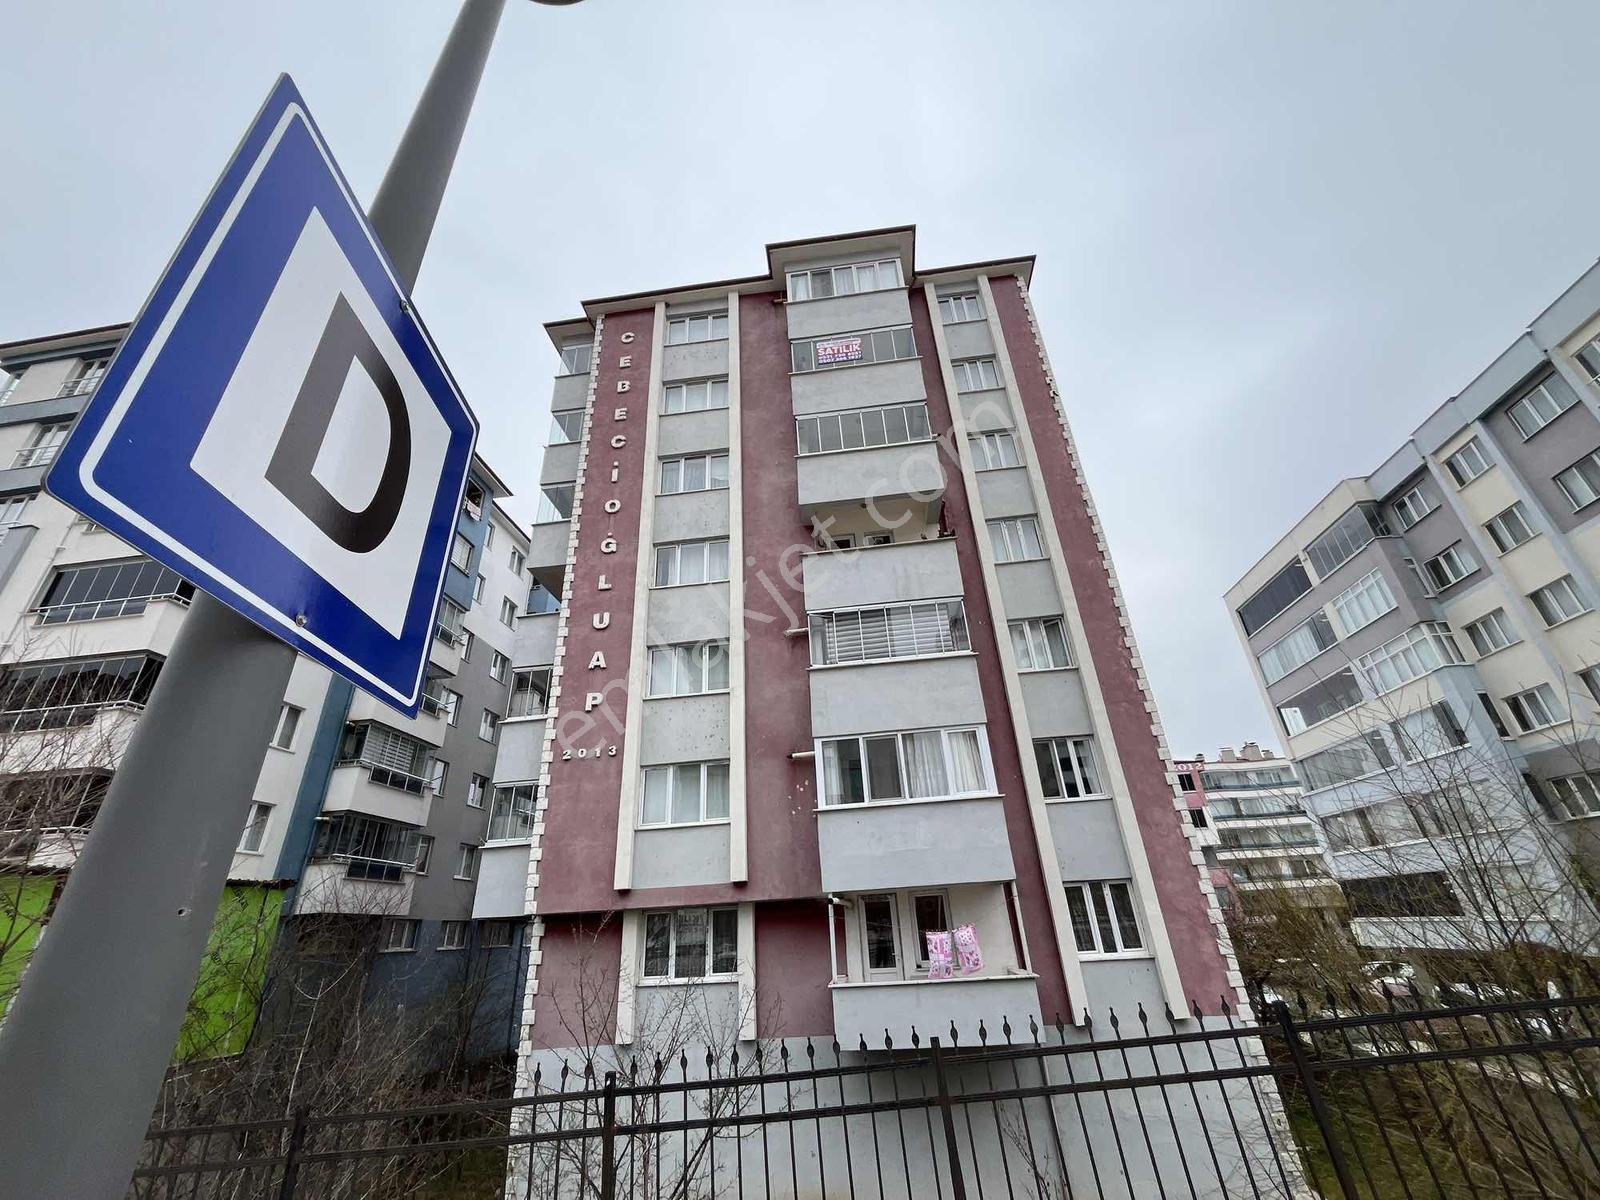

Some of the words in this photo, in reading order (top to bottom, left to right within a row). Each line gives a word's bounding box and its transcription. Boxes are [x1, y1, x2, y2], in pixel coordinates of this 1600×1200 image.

[818, 343, 860, 356] SATILIK
[263, 290, 412, 554] D
[562, 745, 617, 761] 2013
